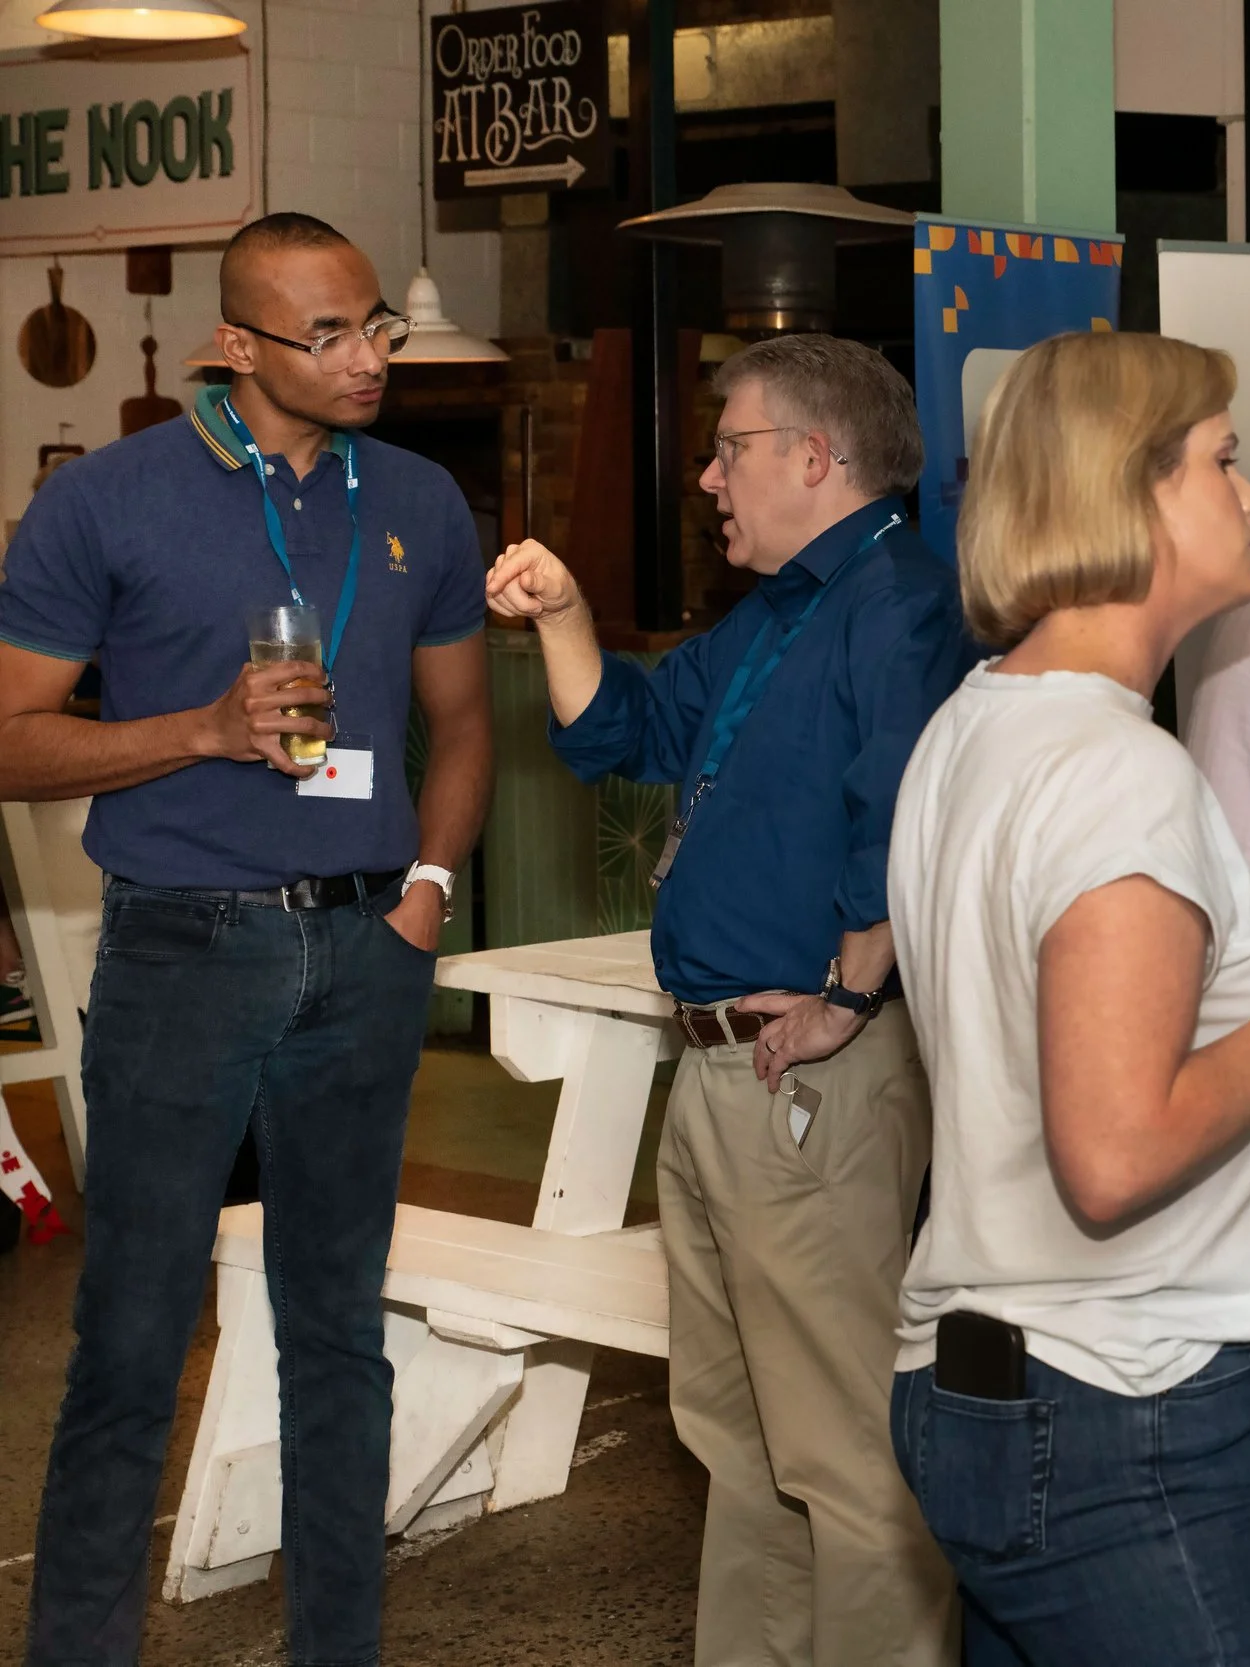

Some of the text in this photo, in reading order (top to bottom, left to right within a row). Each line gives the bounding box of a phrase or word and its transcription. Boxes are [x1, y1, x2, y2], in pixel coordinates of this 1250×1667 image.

[0, 87, 234, 199] HE NOOK
[435, 76, 598, 167] AT BAR
